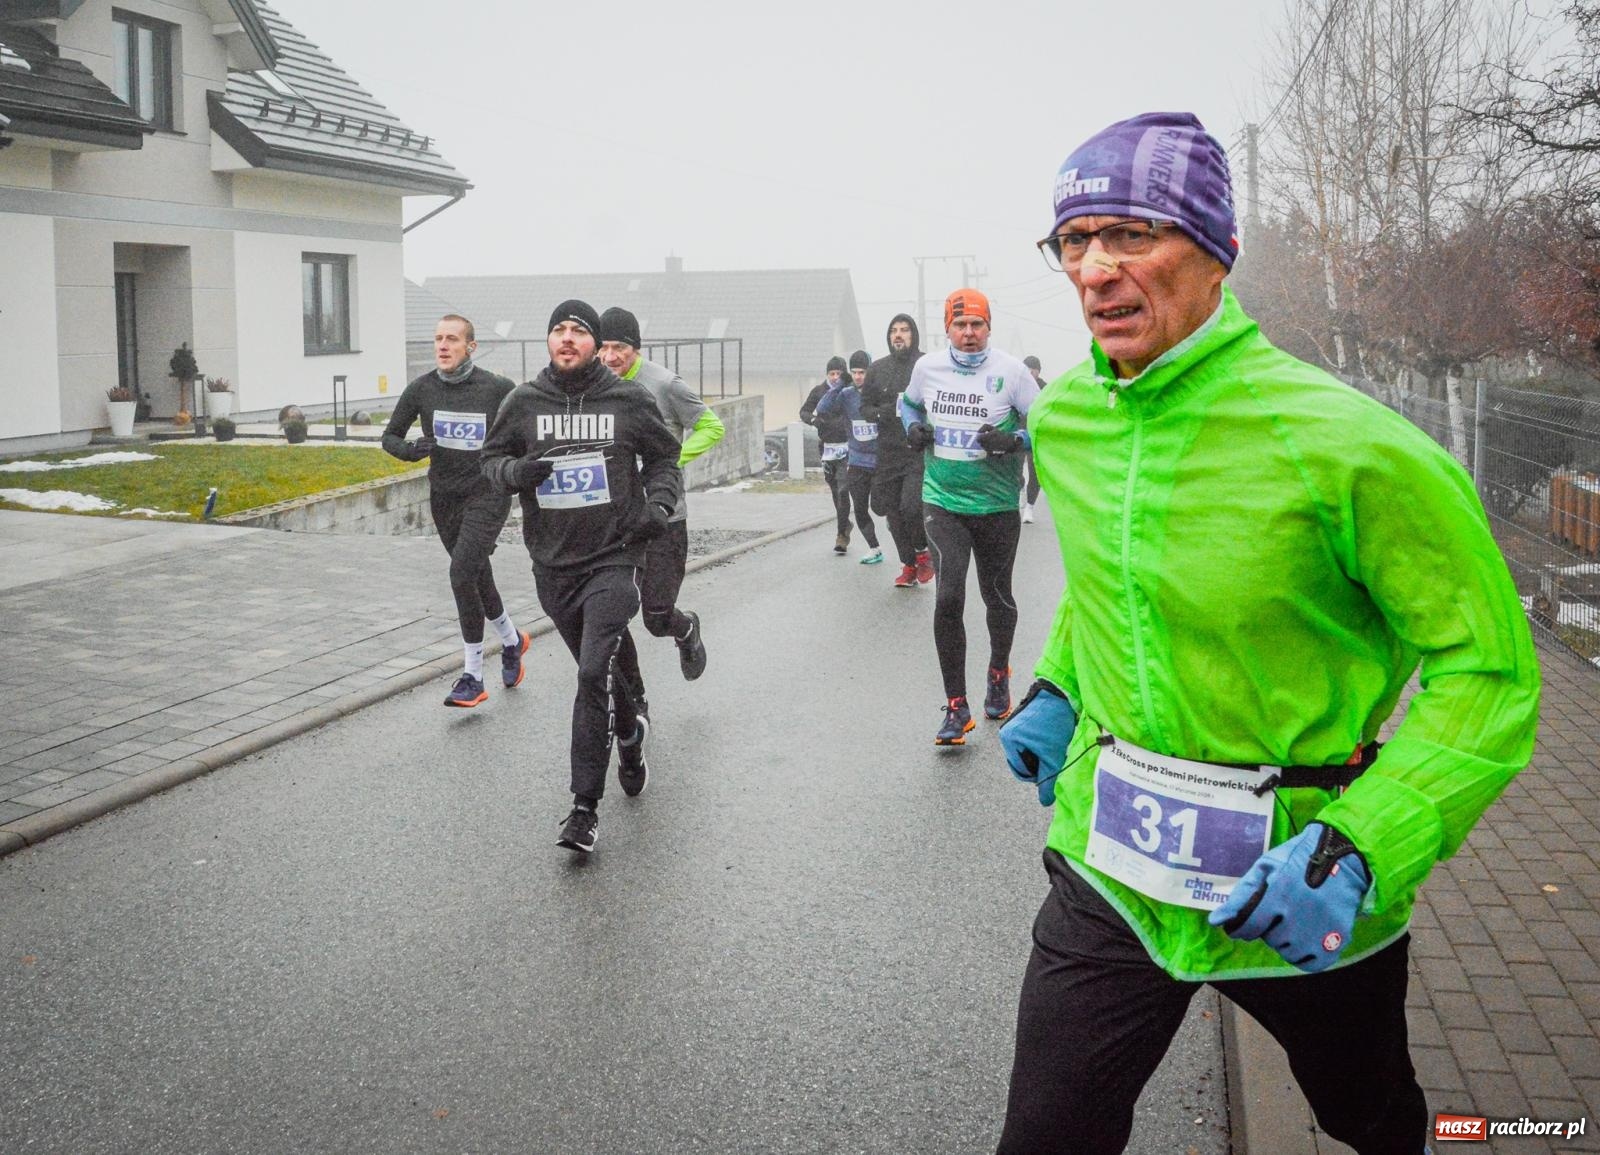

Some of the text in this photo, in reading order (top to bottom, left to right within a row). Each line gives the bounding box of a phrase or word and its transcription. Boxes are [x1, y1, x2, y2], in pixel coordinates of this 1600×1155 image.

[1146, 128, 1181, 207] RUNNERS
[936, 390, 984, 405] TEAM OF
[932, 401, 988, 418] RUNNERS
[443, 423, 477, 439] 162
[537, 414, 614, 440] PUMA
[942, 429, 977, 448] 117
[548, 468, 593, 493] 159
[1147, 764, 1159, 772] po
[1160, 766, 1186, 780] Ziemi
[1130, 794, 1202, 868] 31
